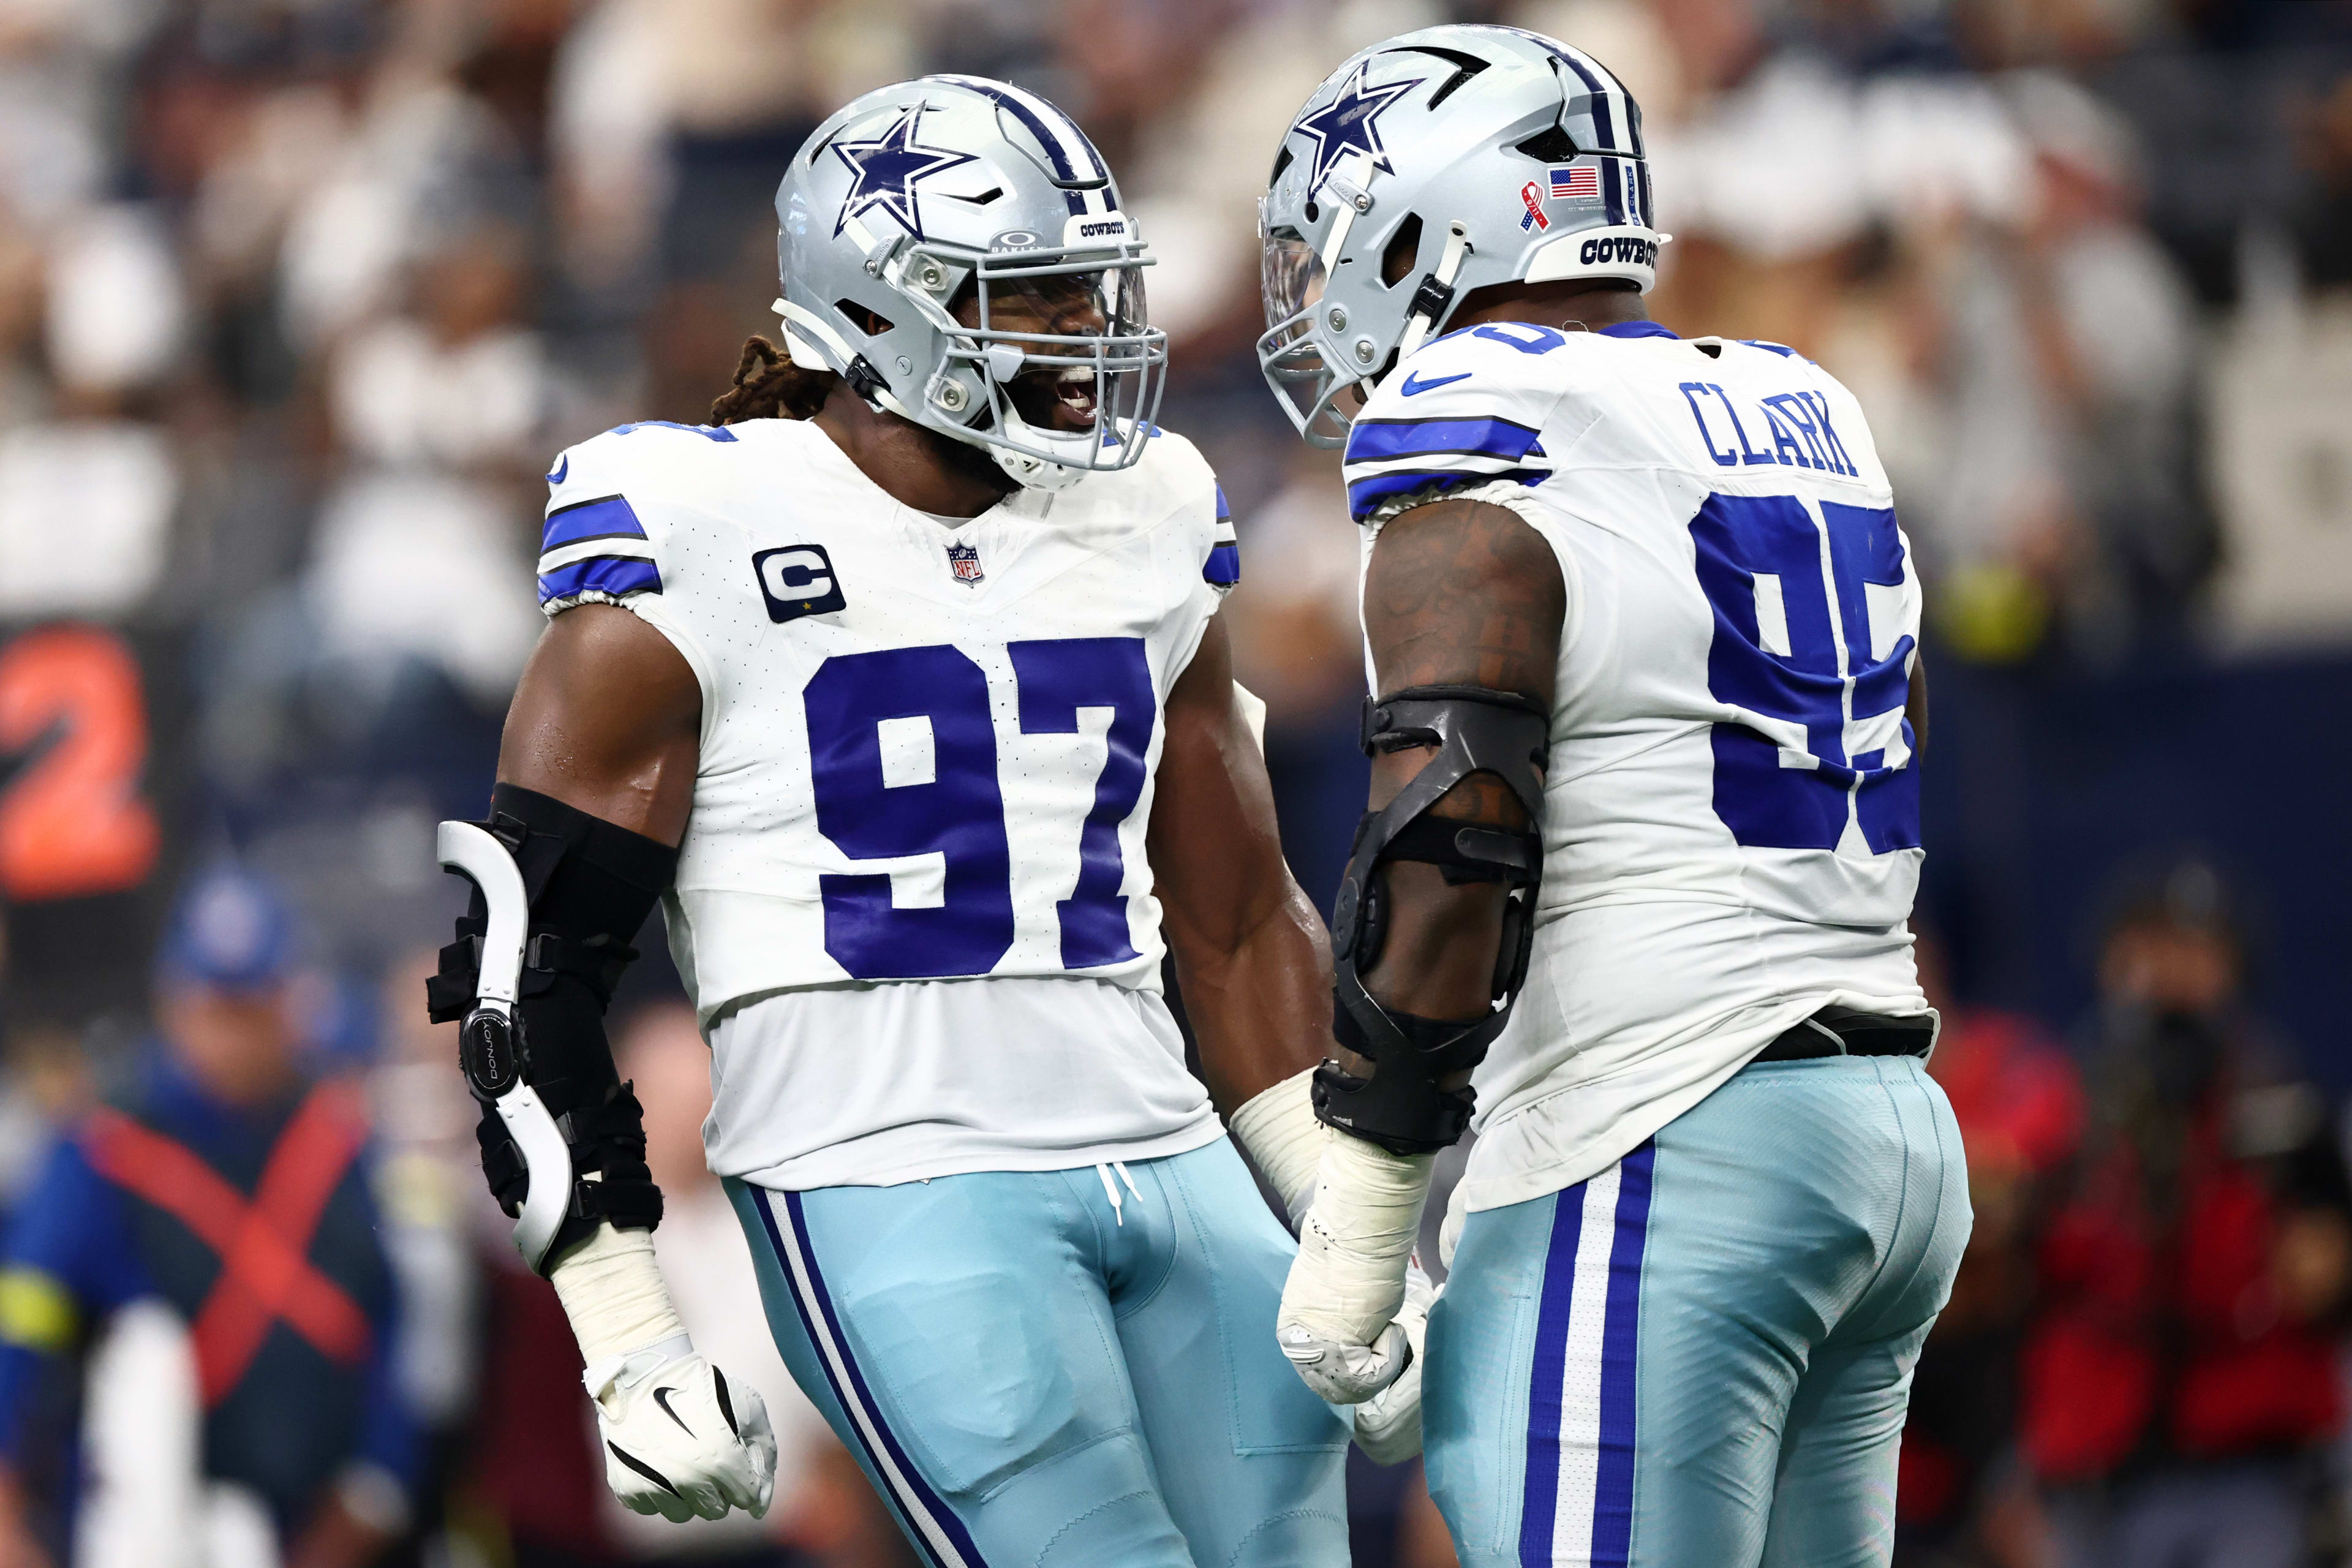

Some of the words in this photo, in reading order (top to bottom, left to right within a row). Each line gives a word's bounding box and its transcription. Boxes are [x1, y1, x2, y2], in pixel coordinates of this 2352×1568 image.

[1080, 221, 1125, 237] COWBOYS
[1526, 199, 1540, 216] 9/11
[1580, 237, 1658, 270] COWBOY
[1679, 382, 1858, 477] CLARK
[761, 550, 832, 601] C
[954, 560, 981, 578] NFL
[1689, 491, 1923, 855] 95
[0, 622, 162, 902] 2
[803, 636, 1156, 979] 97
[482, 1020, 498, 1079] DONJOY
